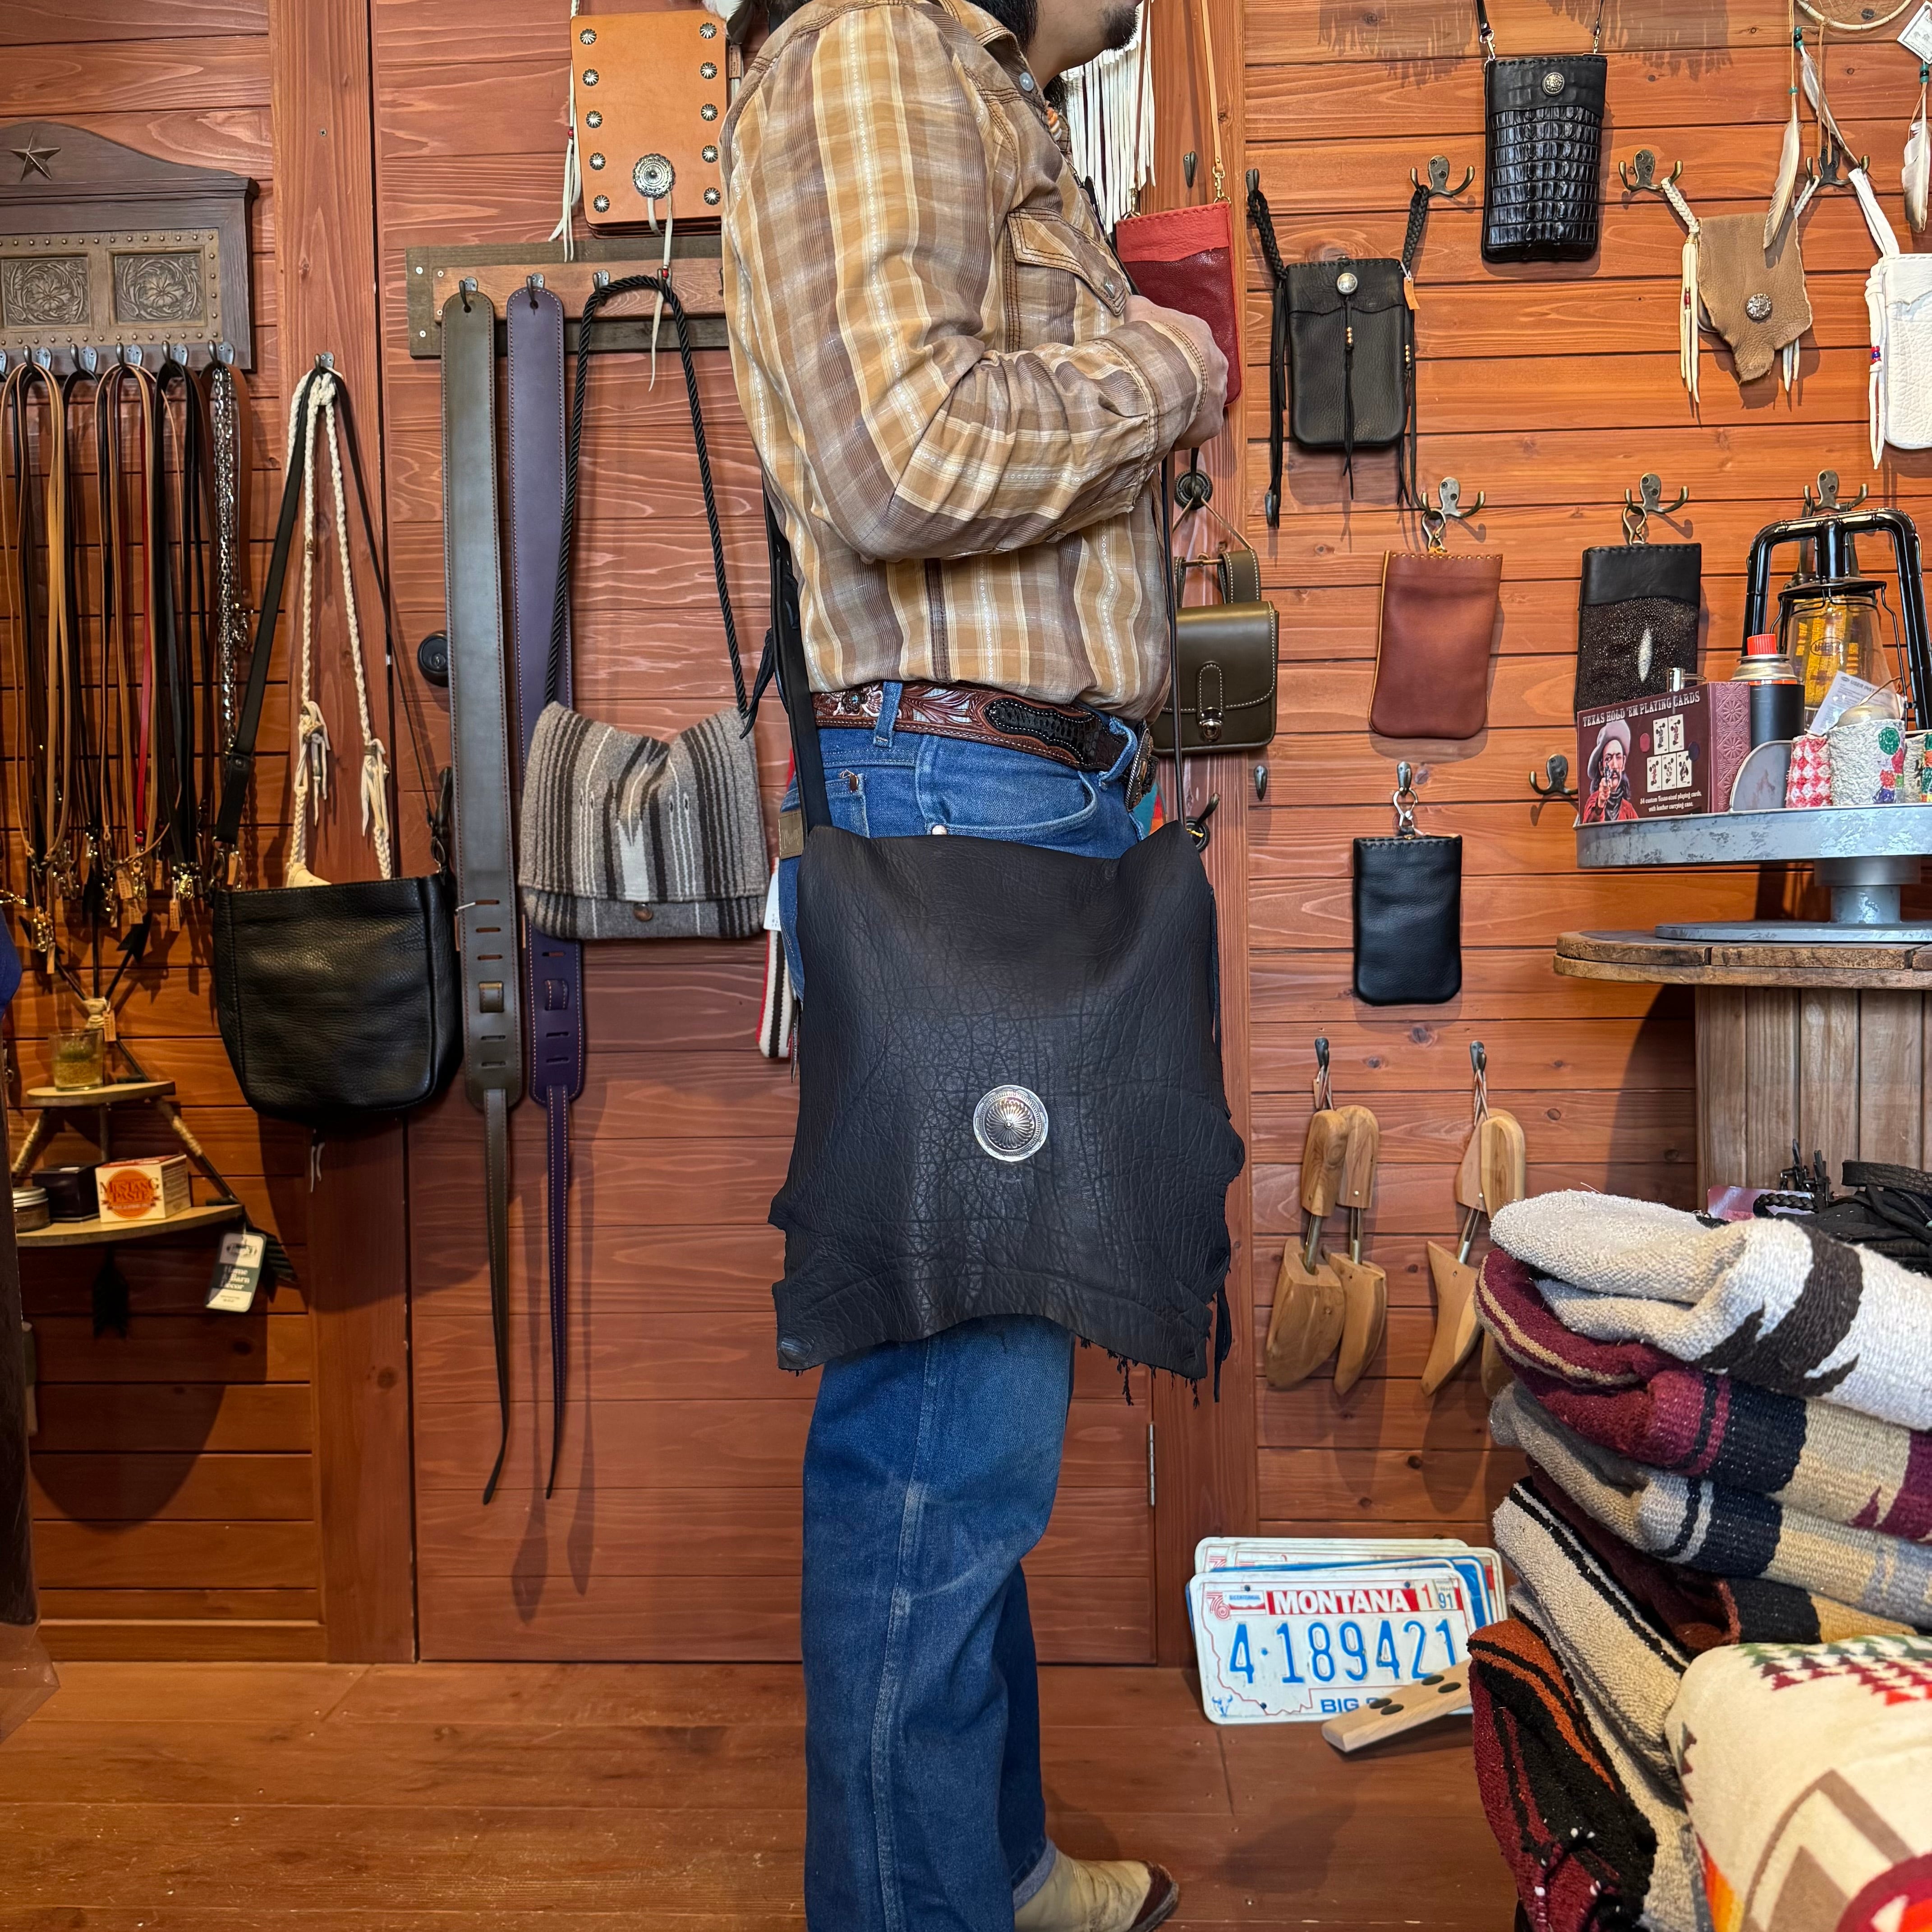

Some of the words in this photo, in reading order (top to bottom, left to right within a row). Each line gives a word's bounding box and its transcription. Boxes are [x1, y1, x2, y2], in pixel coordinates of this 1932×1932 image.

[1582, 713, 1605, 727] TEXAS
[1606, 708, 1625, 722] HOLD
[1640, 697, 1672, 715] PLAYING
[1673, 690, 1700, 707] CARDS
[1678, 792, 1691, 800] playing
[1669, 802, 1684, 810] carrying
[100, 1177, 160, 1194] MUSTANG
[113, 1191, 147, 1202] PASTE
[1273, 1589, 1411, 1614] MONTANA
[1421, 1583, 1432, 1608] 1
[1438, 1592, 1453, 1609] 91
[1320, 1697, 1359, 1713] BIG
